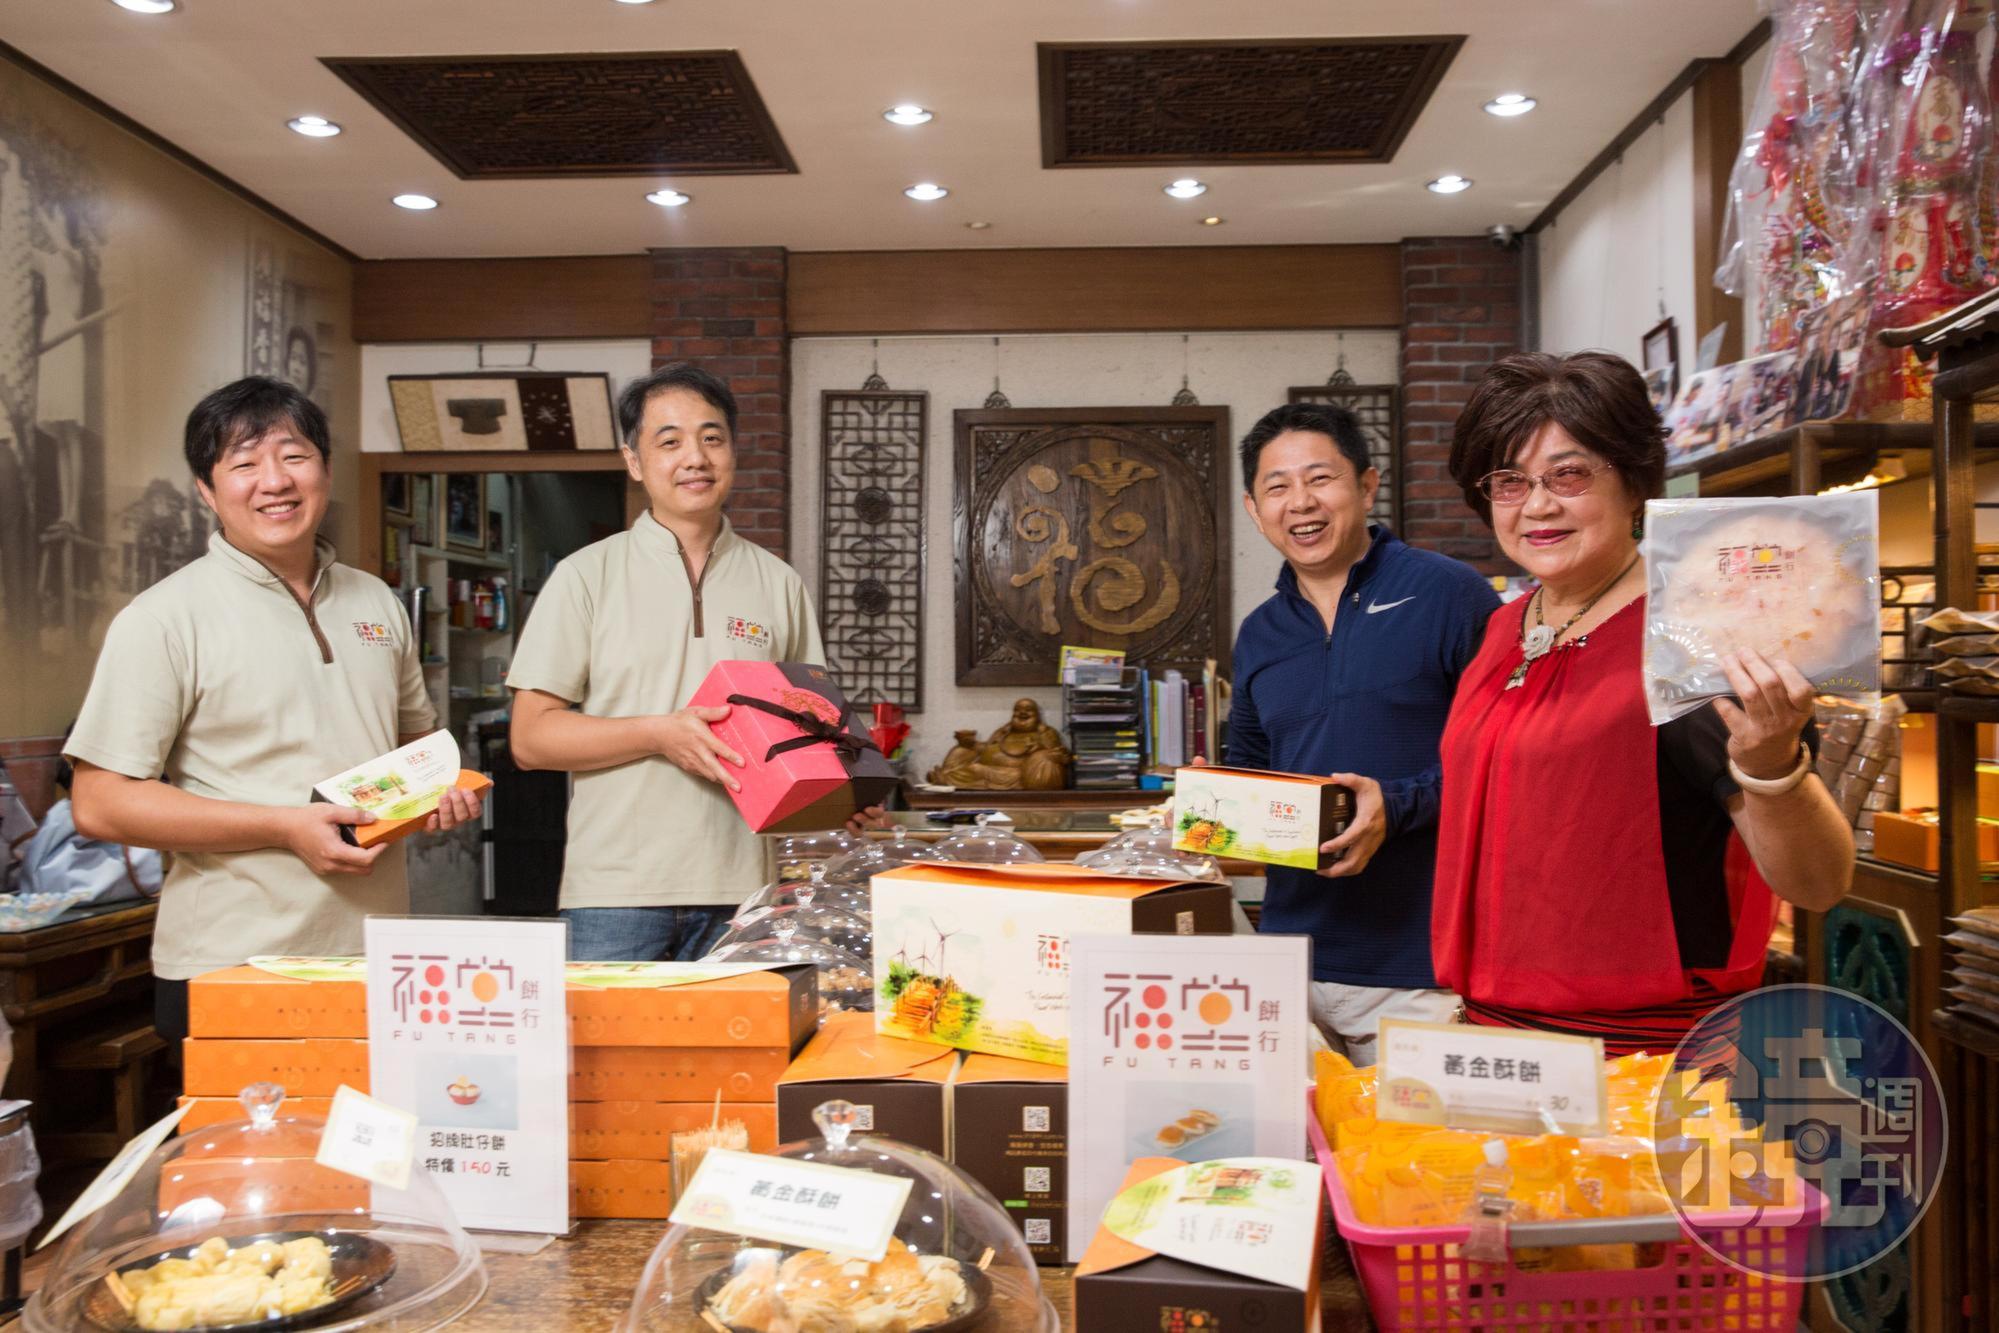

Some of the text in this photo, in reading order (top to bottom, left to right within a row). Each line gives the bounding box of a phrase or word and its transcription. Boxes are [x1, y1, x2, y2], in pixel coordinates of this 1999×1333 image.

[1257, 999, 1281, 1054] 餅行
[393, 1030, 517, 1045] FU TANG
[1103, 1055, 1251, 1071] FU TANG
[496, 1161, 511, 1177] 元
